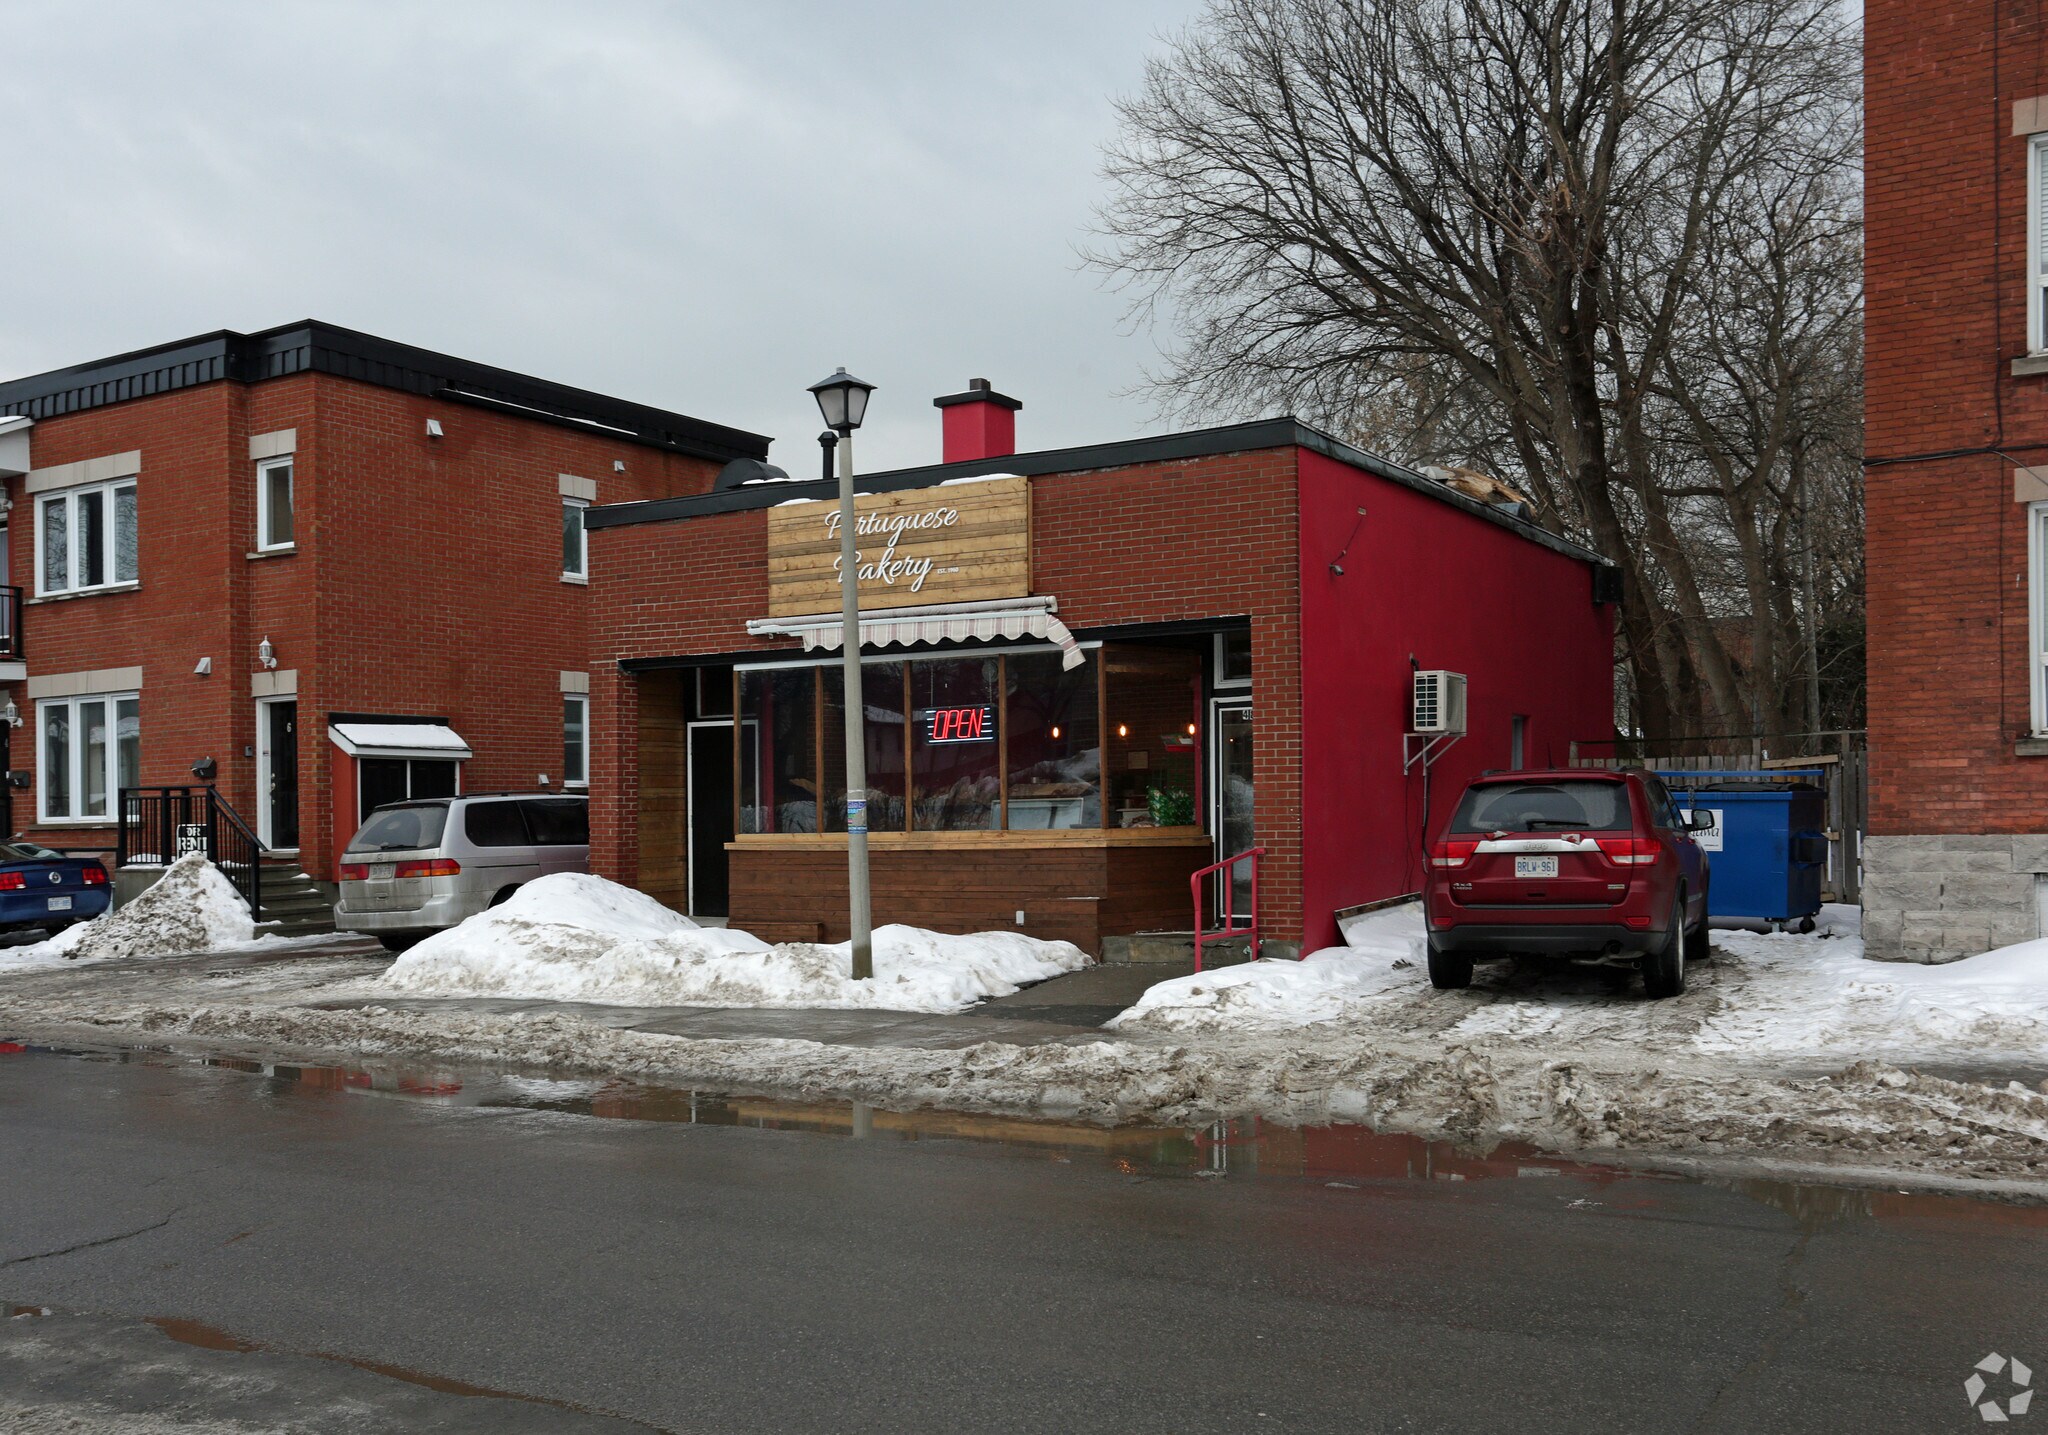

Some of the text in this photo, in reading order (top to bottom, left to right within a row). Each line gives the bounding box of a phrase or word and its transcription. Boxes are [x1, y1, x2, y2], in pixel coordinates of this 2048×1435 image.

[825, 507, 958, 547] Prtuguese
[933, 709, 984, 739] OPEN
[178, 837, 207, 850] RENT
[1523, 842, 1548, 851] Jeep
